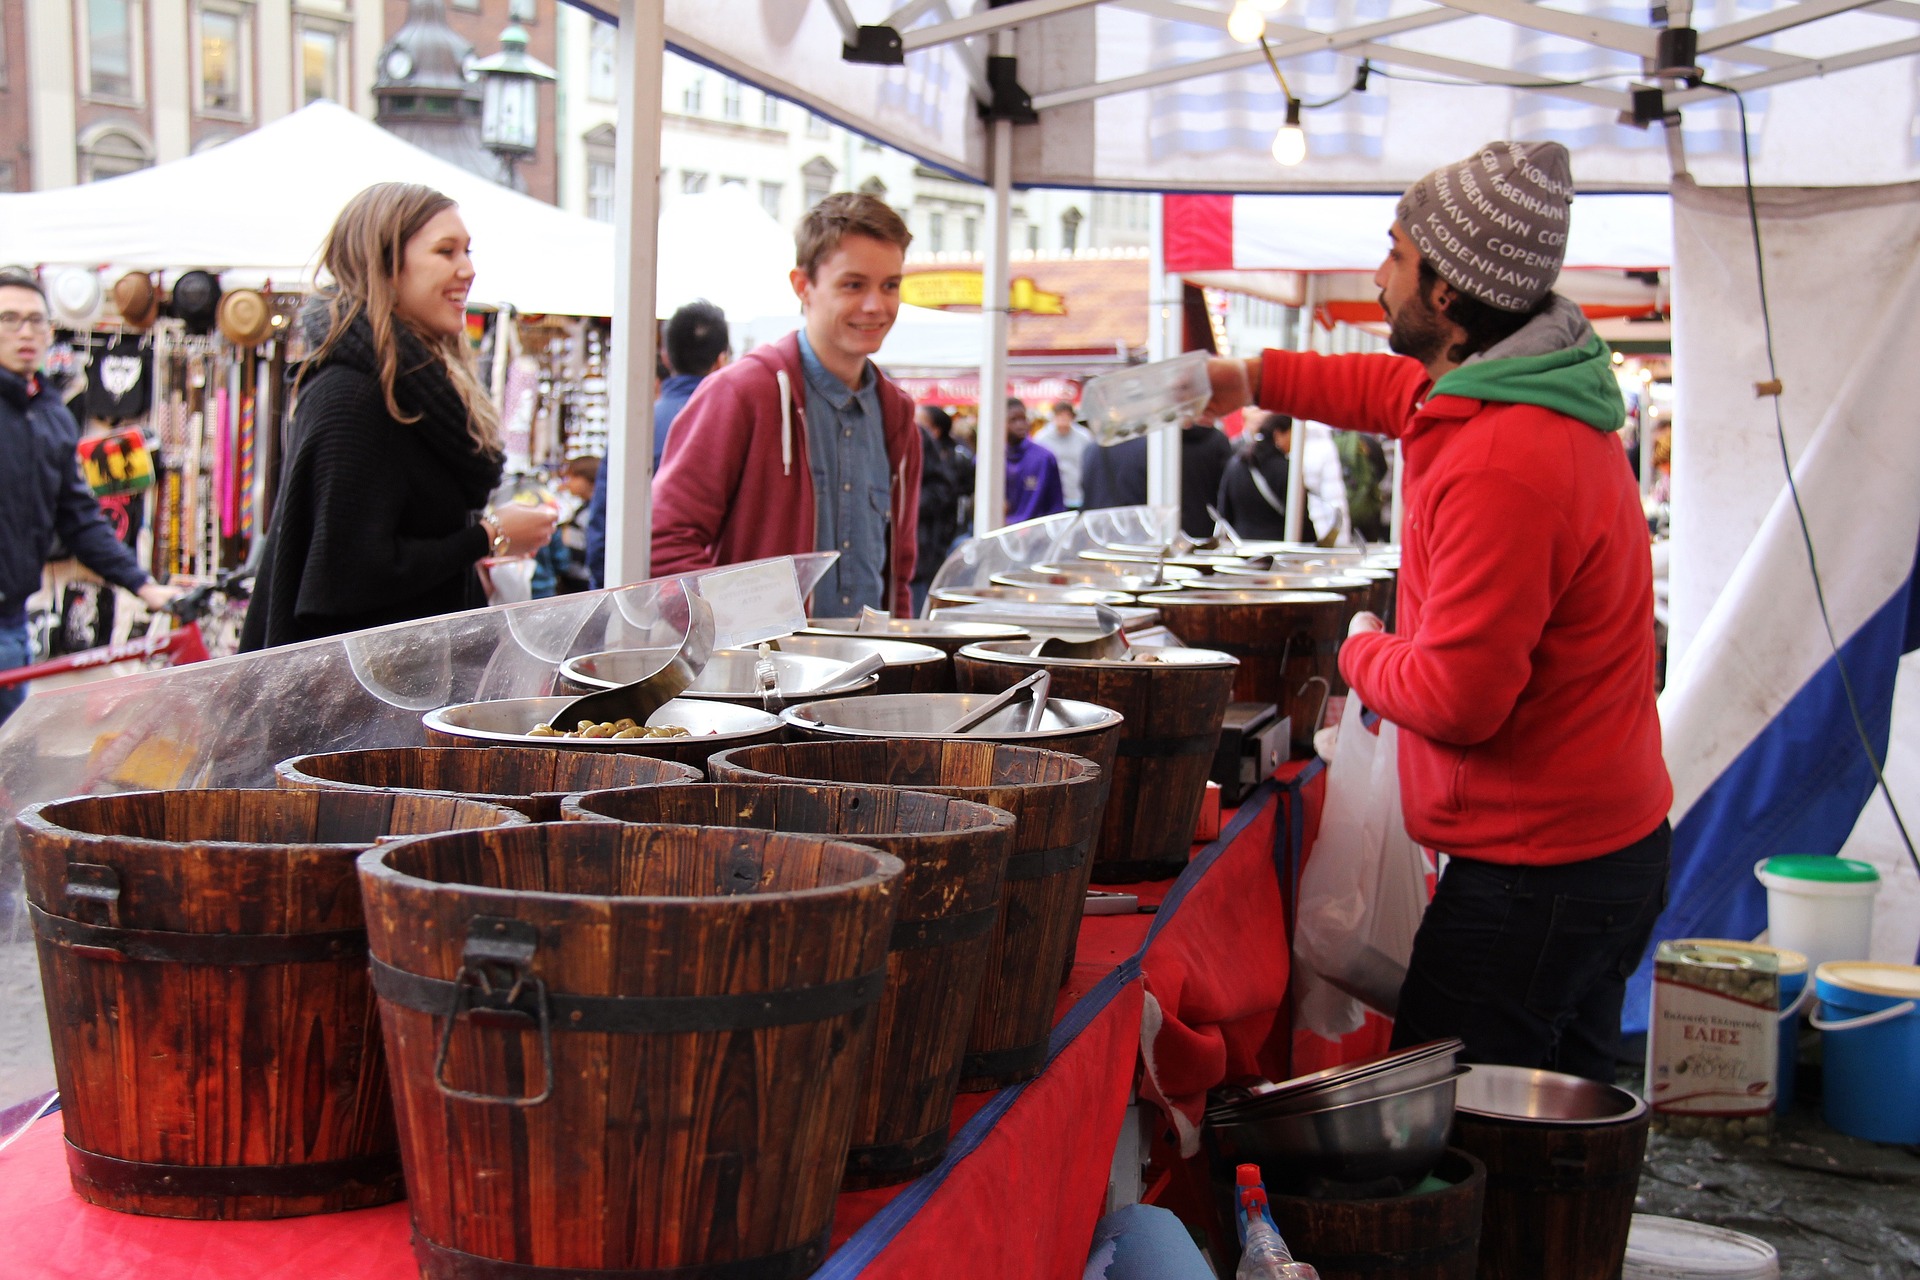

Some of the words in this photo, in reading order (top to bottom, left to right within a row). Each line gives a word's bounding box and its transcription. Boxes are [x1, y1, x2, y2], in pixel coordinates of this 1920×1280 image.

[1458, 166, 1531, 237] KØBENHAVN
[1410, 223, 1530, 311] COPENHAGEN
[1426, 212, 1540, 291] KØBENHAVN
